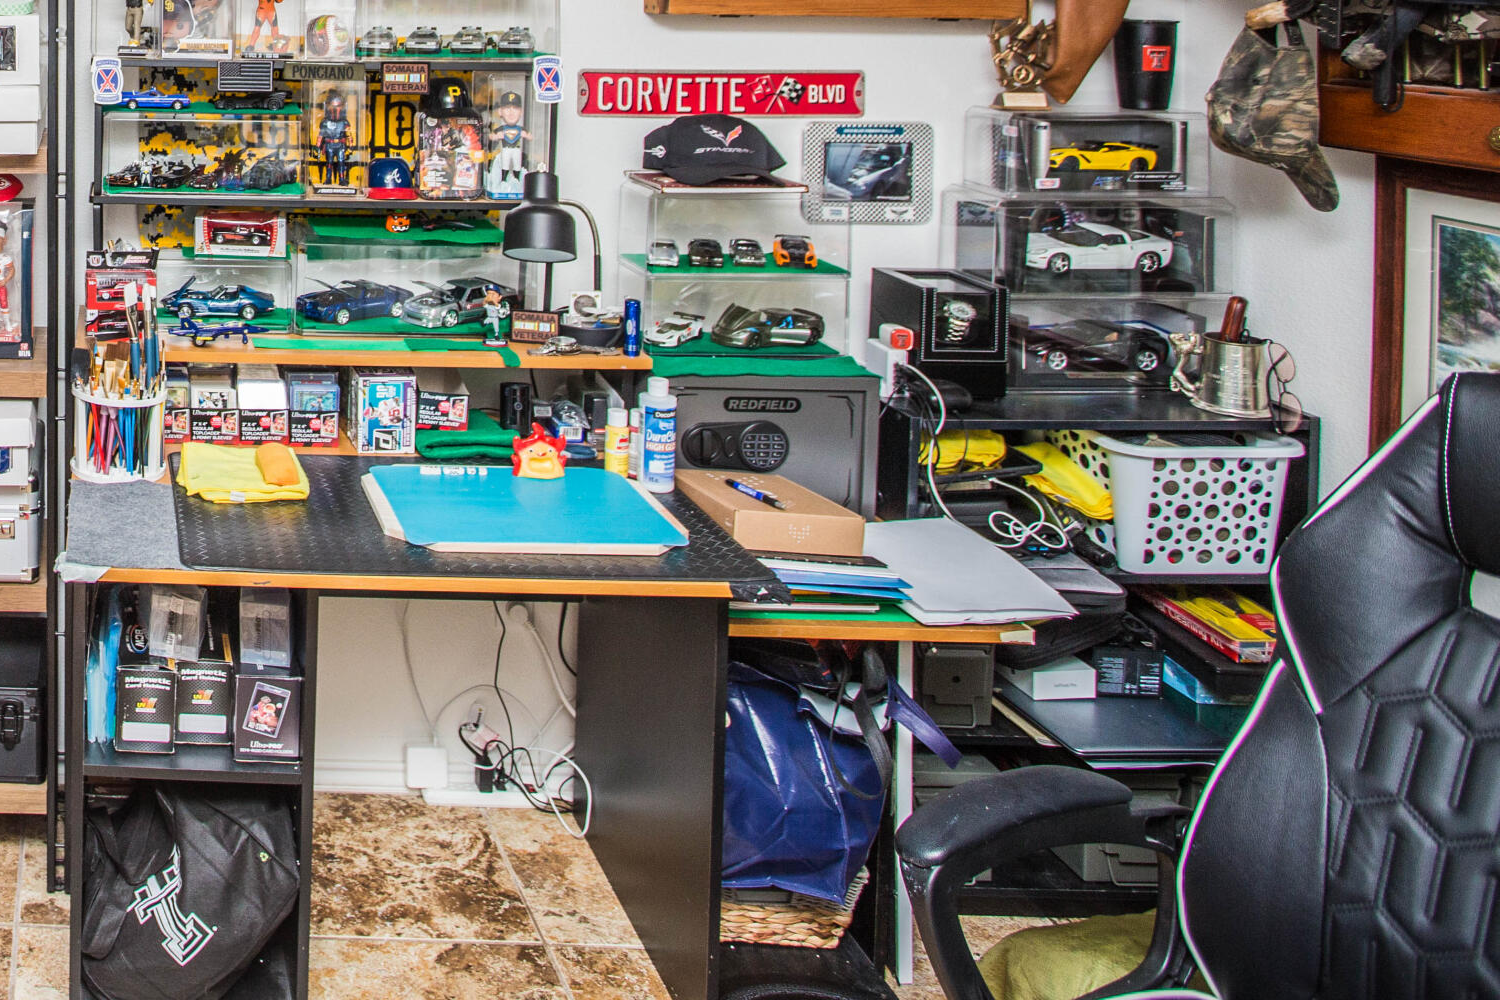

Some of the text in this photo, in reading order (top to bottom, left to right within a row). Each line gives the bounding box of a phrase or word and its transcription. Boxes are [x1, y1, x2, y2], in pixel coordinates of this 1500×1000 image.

[291, 65, 354, 80] PONCIANO
[385, 65, 426, 73] SOMALIA
[385, 83, 427, 91] VETERAN
[448, 86, 461, 103] P
[508, 93, 515, 102] P
[597, 76, 846, 113] CORVETTE BLVD
[384, 168, 402, 184] A
[513, 312, 557, 321] SOMALIA
[727, 399, 798, 411] REDFIELD
[646, 441, 664, 450] HIGH
[134, 628, 145, 649] BCW
[181, 668, 227, 678] Magnetic
[124, 675, 172, 686] Magnetic
